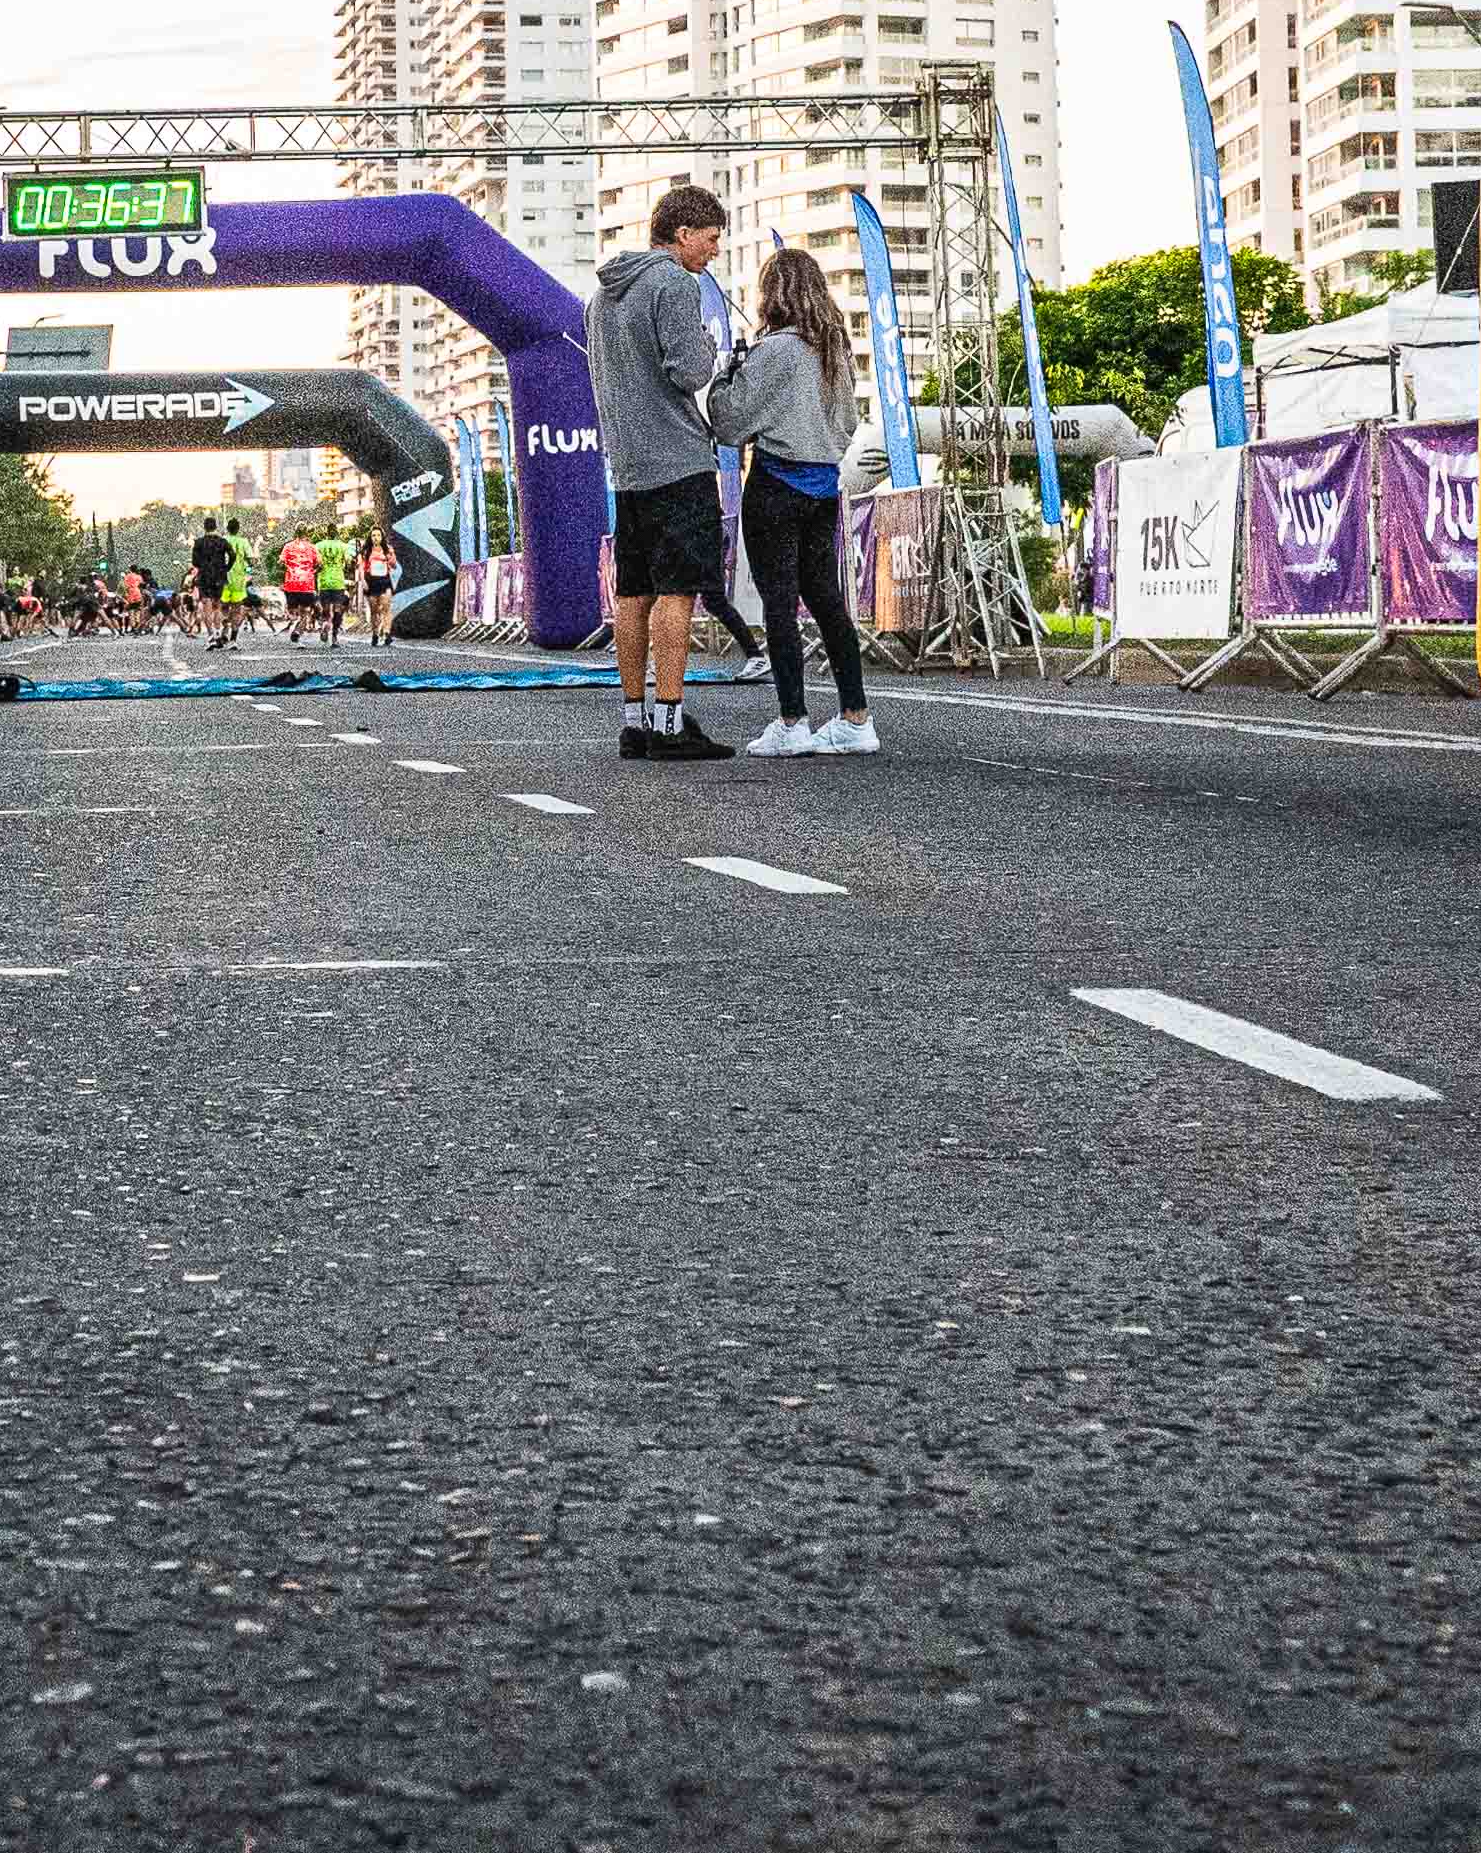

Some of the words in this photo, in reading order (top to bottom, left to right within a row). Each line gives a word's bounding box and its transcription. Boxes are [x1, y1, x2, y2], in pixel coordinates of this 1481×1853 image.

[17, 181, 194, 230] 00:36:37
[19, 391, 250, 423] POWERADE
[1050, 419, 1080, 440] VOS
[1141, 515, 1180, 572] 15K
